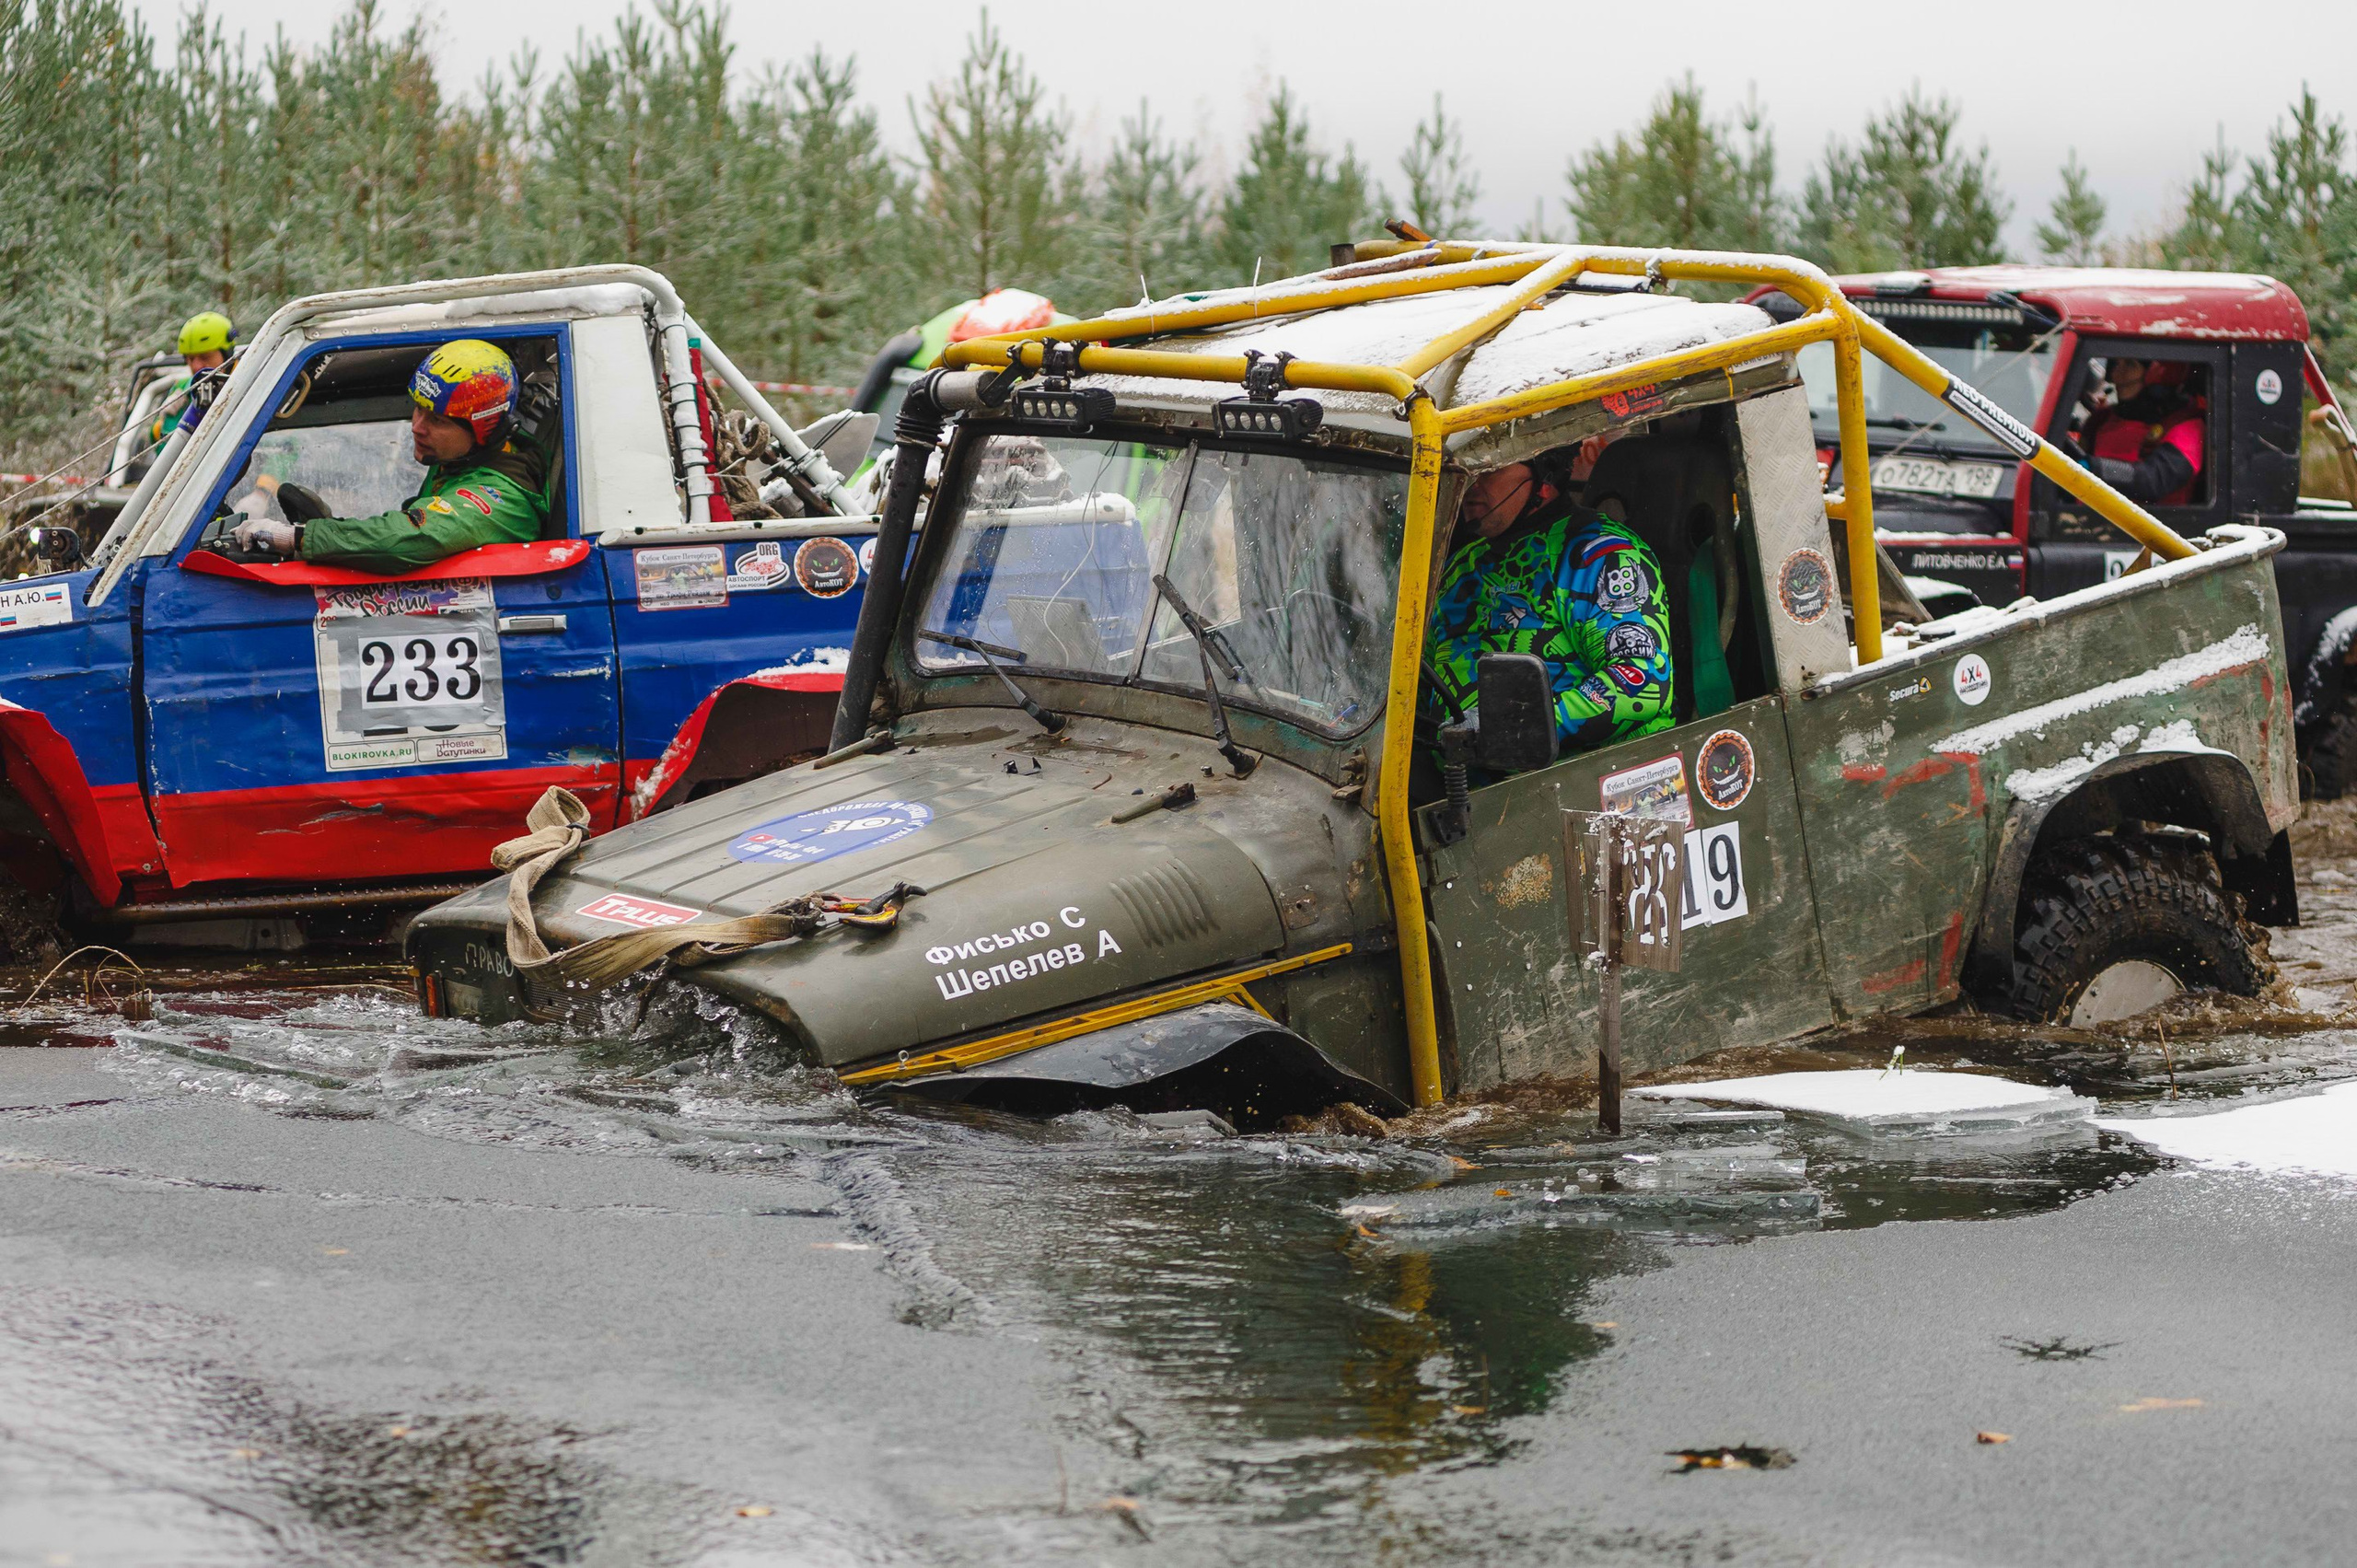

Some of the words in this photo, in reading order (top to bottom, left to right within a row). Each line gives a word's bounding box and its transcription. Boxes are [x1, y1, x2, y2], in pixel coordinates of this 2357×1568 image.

[759, 543, 779, 556] ORG
[640, 554, 660, 563] Кубок
[1911, 553, 1986, 569] ЛИТОВЧЕНКО
[727, 575, 766, 583] АВТОСПОРТ
[14, 591, 44, 607] А.Ю.
[362, 636, 482, 703] 233
[1960, 664, 1983, 684] 4X4
[1889, 683, 1920, 703] Secura
[435, 738, 475, 749] Новые
[332, 747, 412, 761] BLOKIROVKA.RU
[436, 745, 486, 759] Ватутинки
[1606, 781, 1626, 794] Кубок
[1682, 834, 1739, 921] 19
[924, 921, 1051, 965] Фисько
[1060, 906, 1086, 928] С
[935, 943, 1086, 1001] Шепелев
[1097, 929, 1122, 958] А
